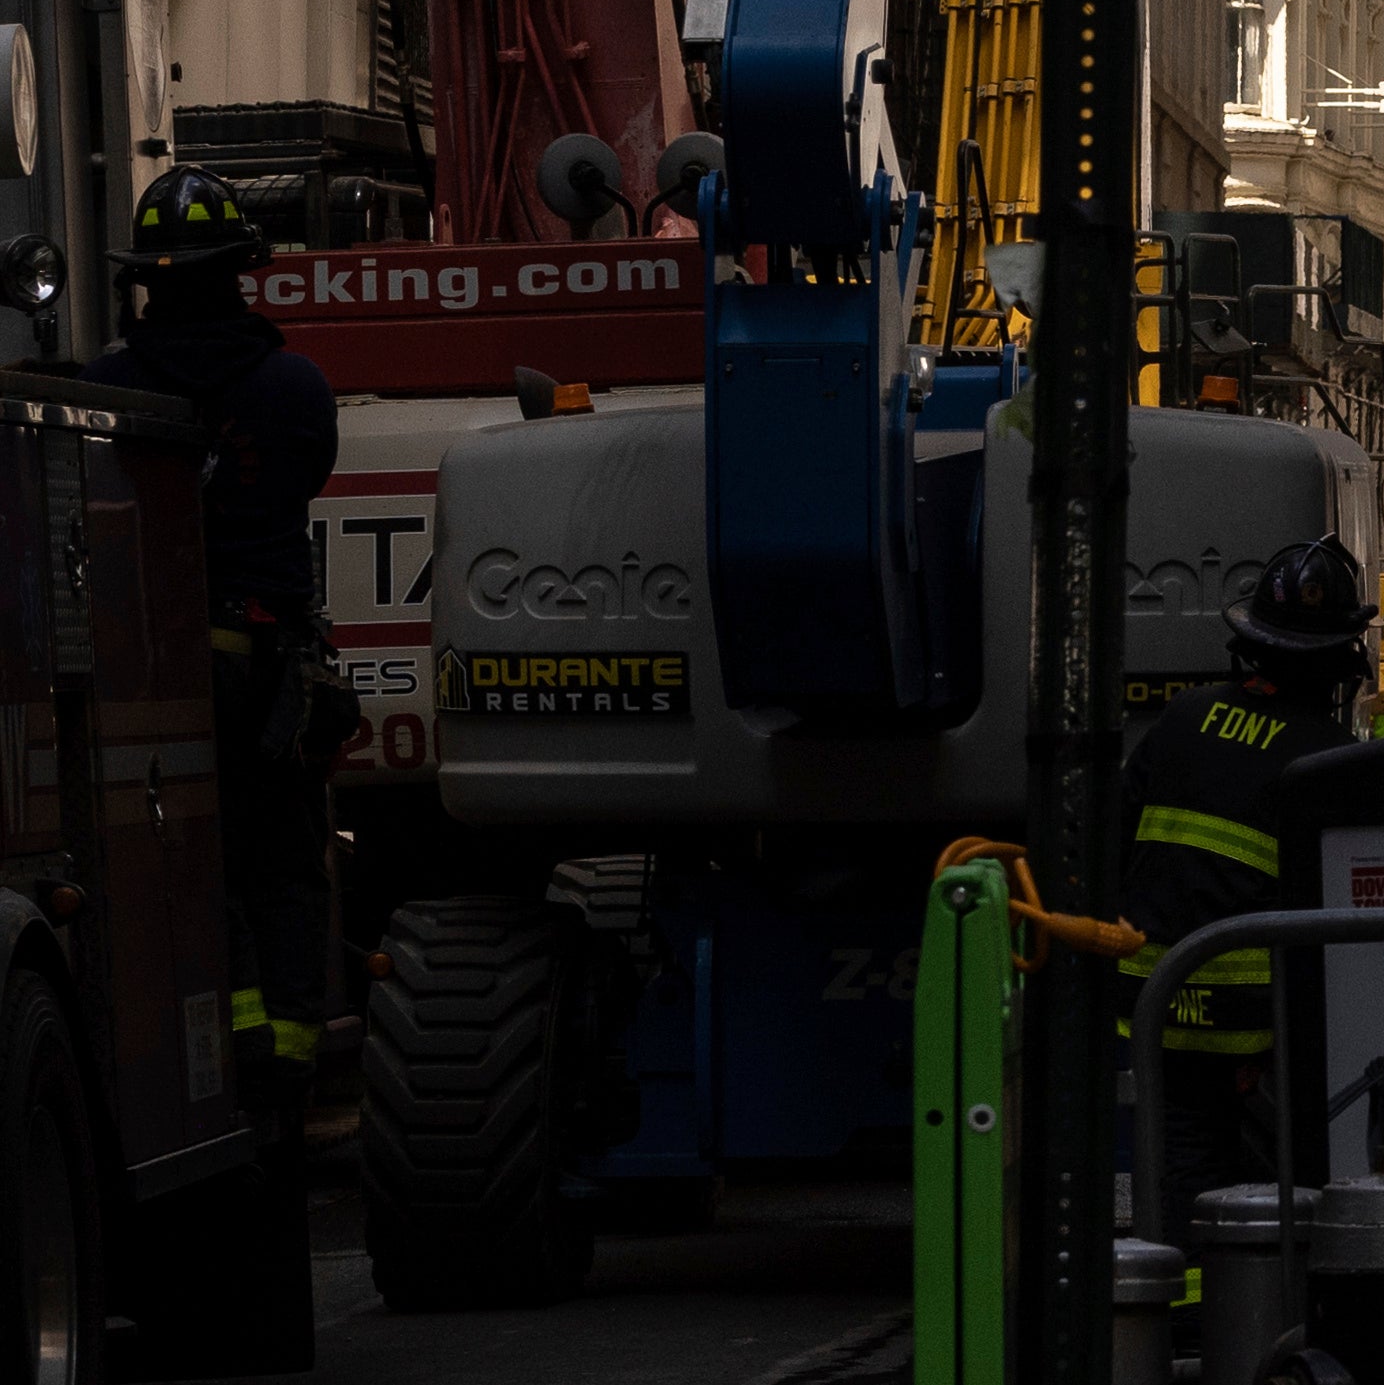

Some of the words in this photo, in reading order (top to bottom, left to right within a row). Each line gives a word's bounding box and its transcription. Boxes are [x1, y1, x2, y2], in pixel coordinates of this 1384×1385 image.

[237, 257, 681, 309] ecking.com
[466, 547, 692, 621] Genie
[472, 656, 685, 688] DURANTE
[486, 692, 671, 712] RENTALS
[1199, 701, 1288, 751] FDNY
[821, 945, 922, 1001] Z-8
[1169, 987, 1215, 1027] INE
